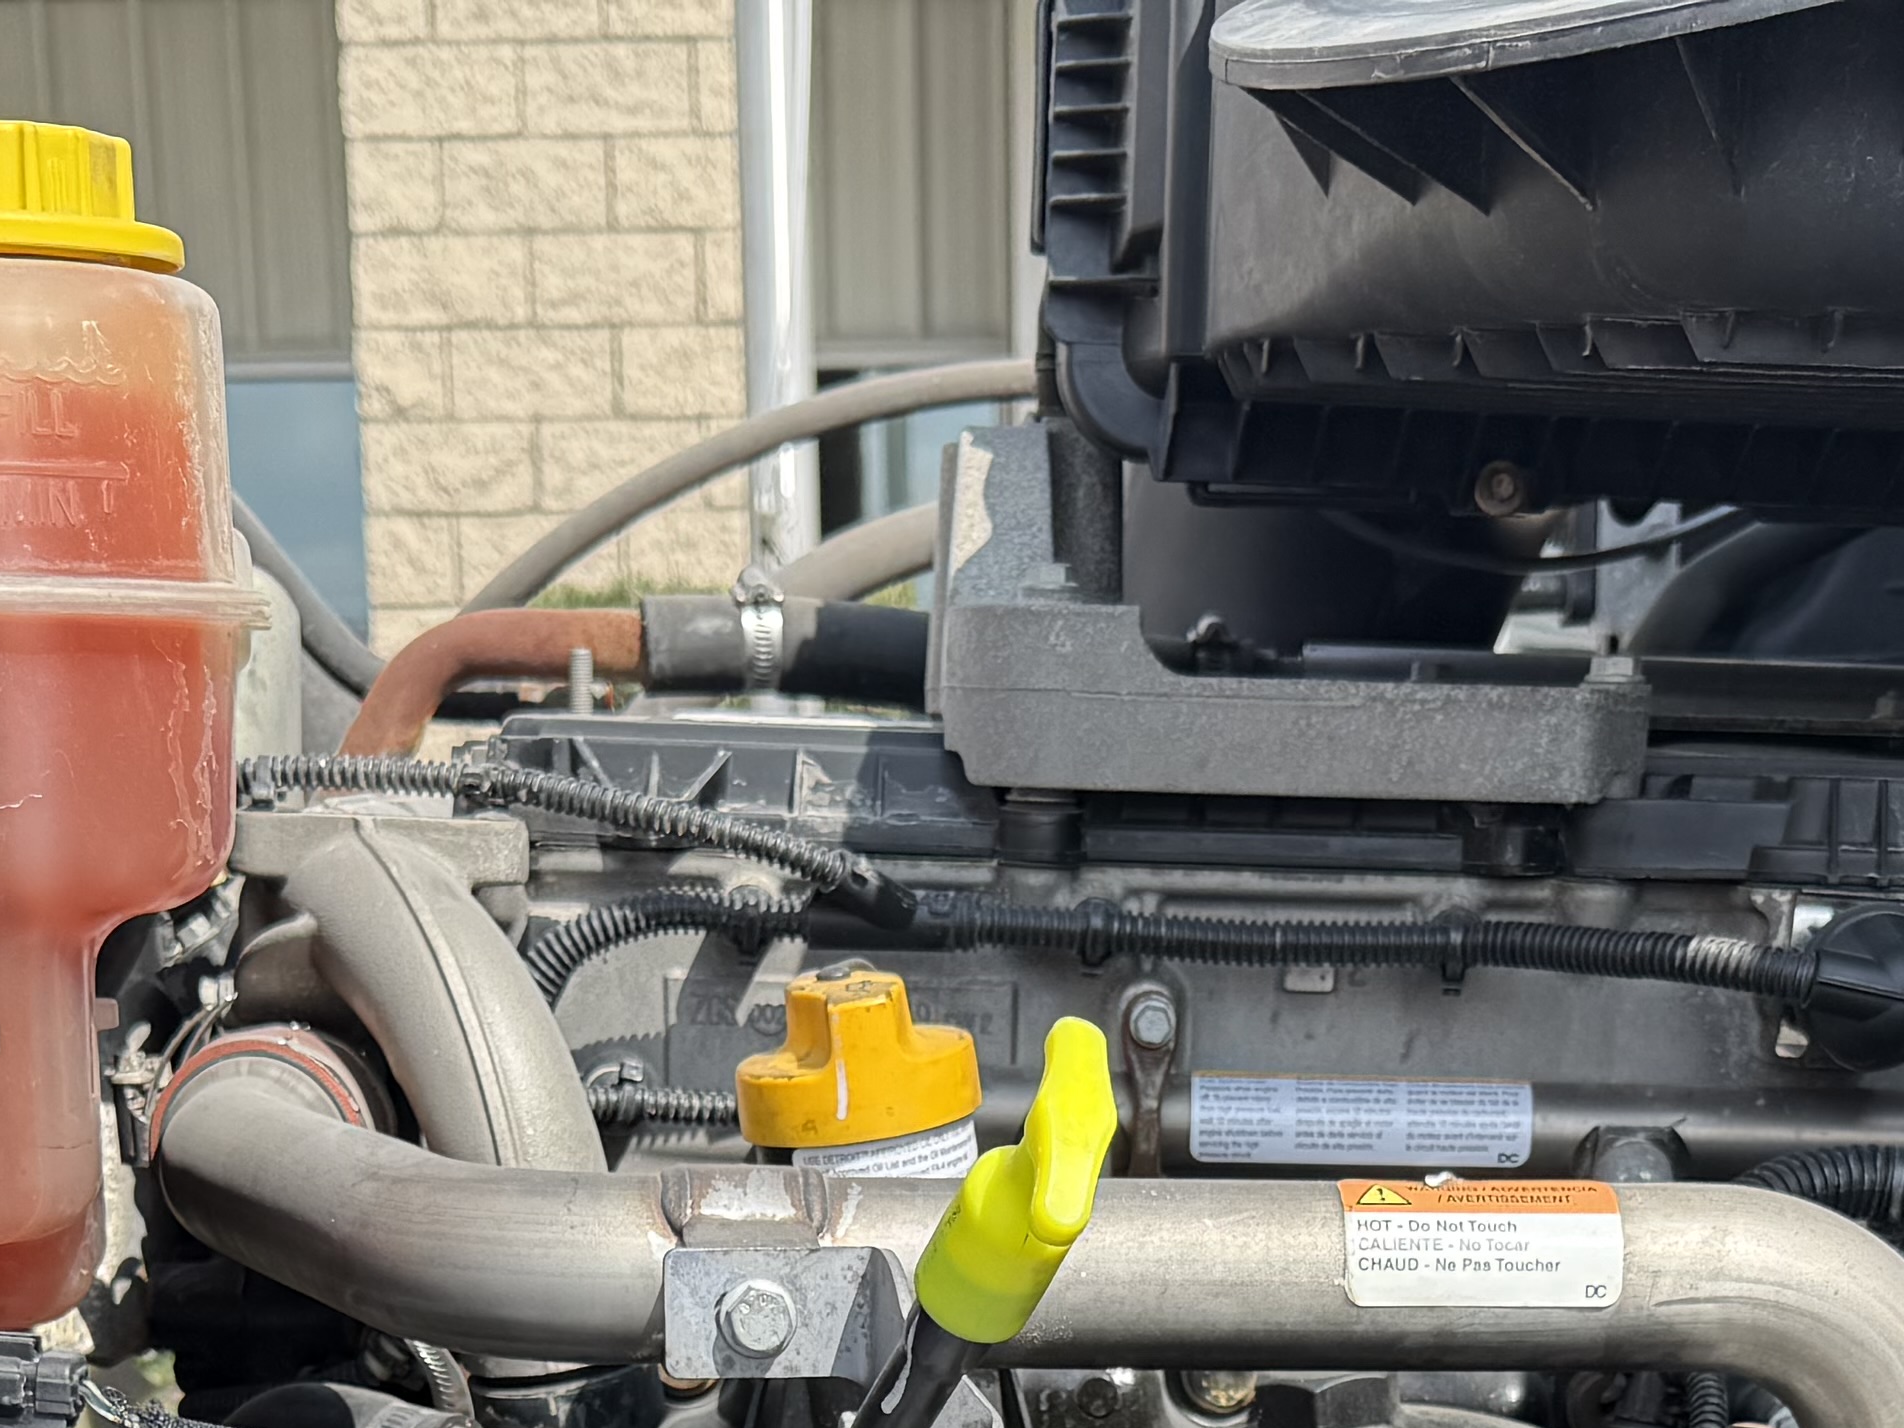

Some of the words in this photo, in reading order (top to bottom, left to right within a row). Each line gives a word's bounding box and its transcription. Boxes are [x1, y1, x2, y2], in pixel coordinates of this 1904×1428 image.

[902, 1155, 917, 1168] and
[1498, 1152, 1520, 1165] DC
[1357, 1219, 1392, 1232] HOT
[1409, 1219, 1431, 1232] Do
[1436, 1219, 1464, 1233] Not
[1468, 1219, 1518, 1233] Touch
[1358, 1237, 1444, 1252] CALIENTE
[1459, 1238, 1481, 1252] No
[1486, 1238, 1530, 1252] Tocar
[1358, 1257, 1419, 1272] CHAUD
[1435, 1258, 1456, 1272] Ne
[1462, 1258, 1492, 1272] Pas
[1494, 1258, 1561, 1273] Toucher
[1585, 1284, 1607, 1299] DC
